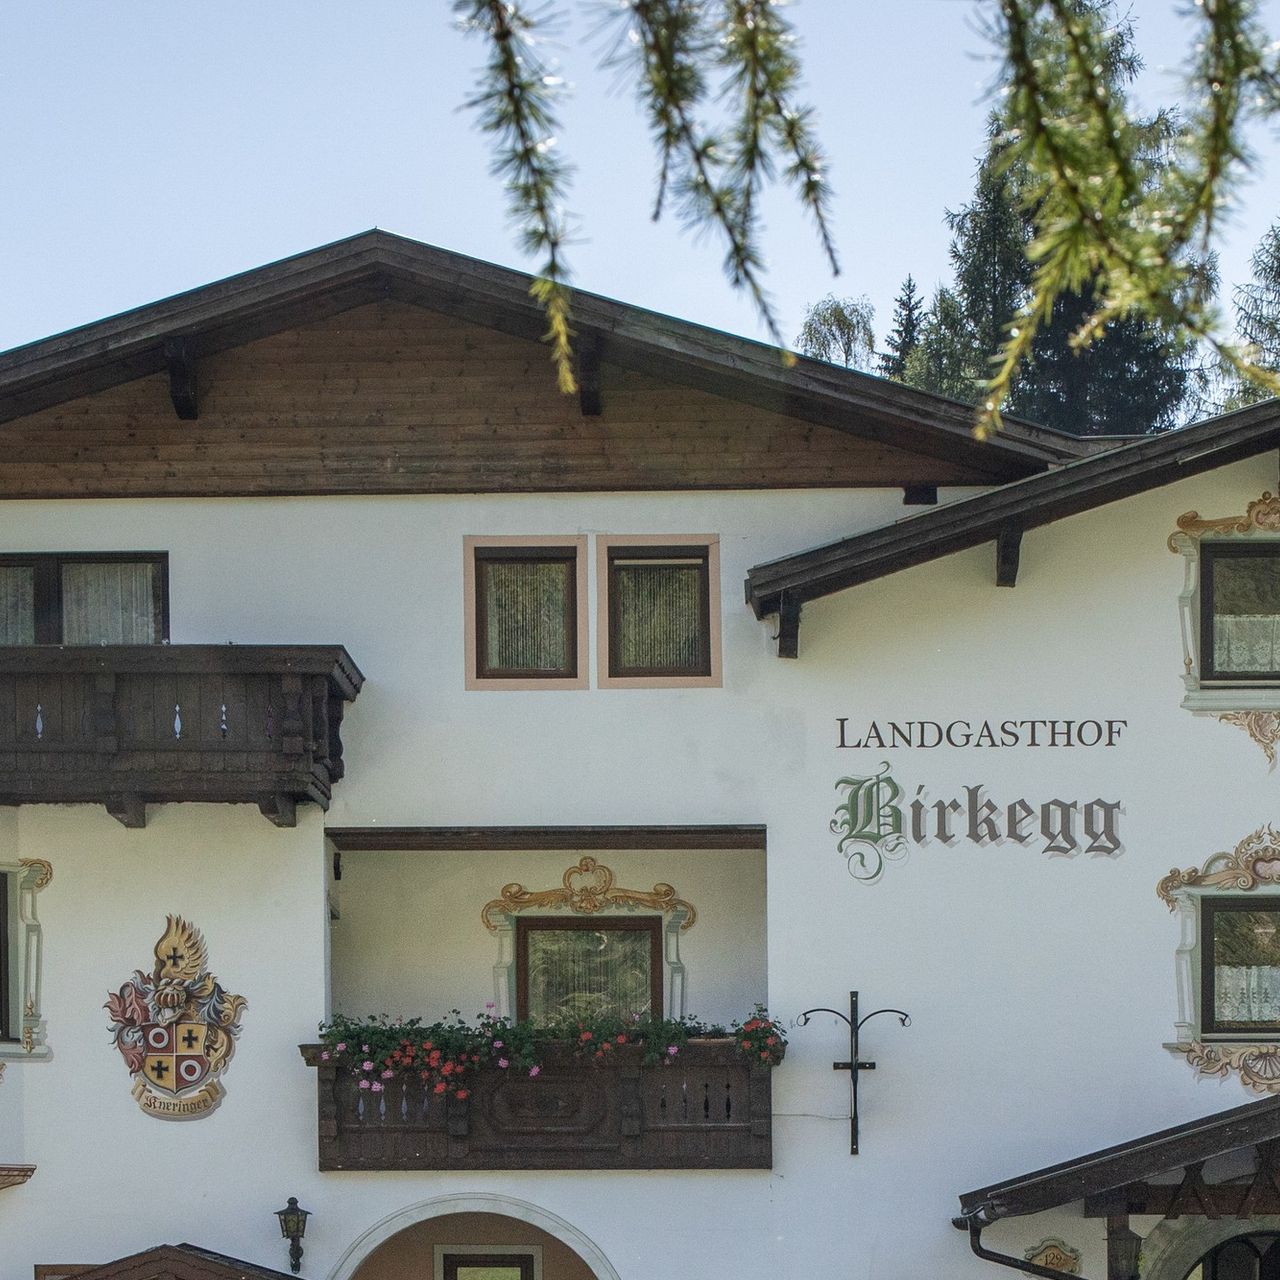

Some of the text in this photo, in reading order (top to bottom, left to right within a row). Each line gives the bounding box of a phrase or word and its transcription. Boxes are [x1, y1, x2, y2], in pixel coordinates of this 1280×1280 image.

[835, 717, 1128, 749] LANDGASTHOF
[830, 761, 1126, 882] Birkegg
[144, 1095, 209, 1113] Kneringer
[1045, 1252, 1062, 1267] 129
